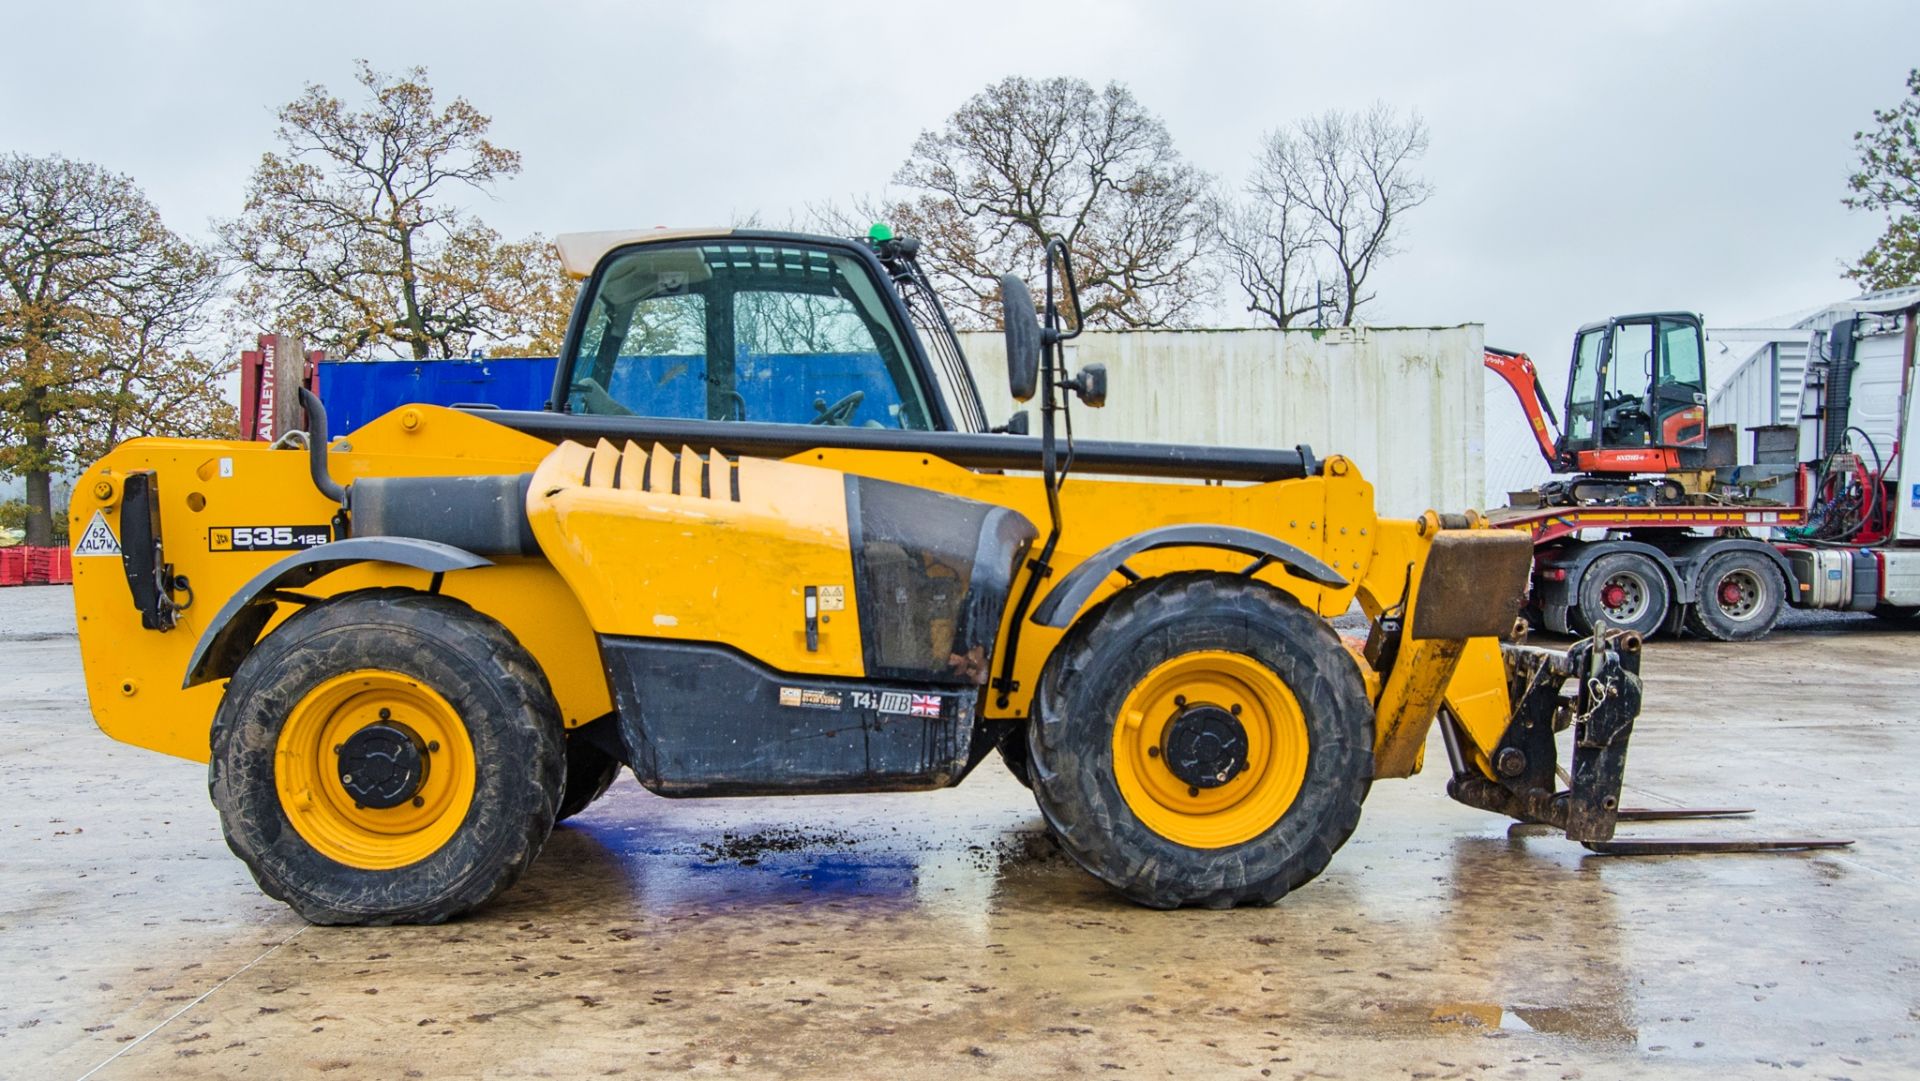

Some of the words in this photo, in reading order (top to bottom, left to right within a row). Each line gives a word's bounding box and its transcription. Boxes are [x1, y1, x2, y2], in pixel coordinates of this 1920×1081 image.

[262, 344, 275, 378] PLANT
[92, 527, 106, 538] 62
[233, 527, 327, 546] 535-125
[86, 539, 113, 550] AL7W
[850, 691, 878, 710] T4i
